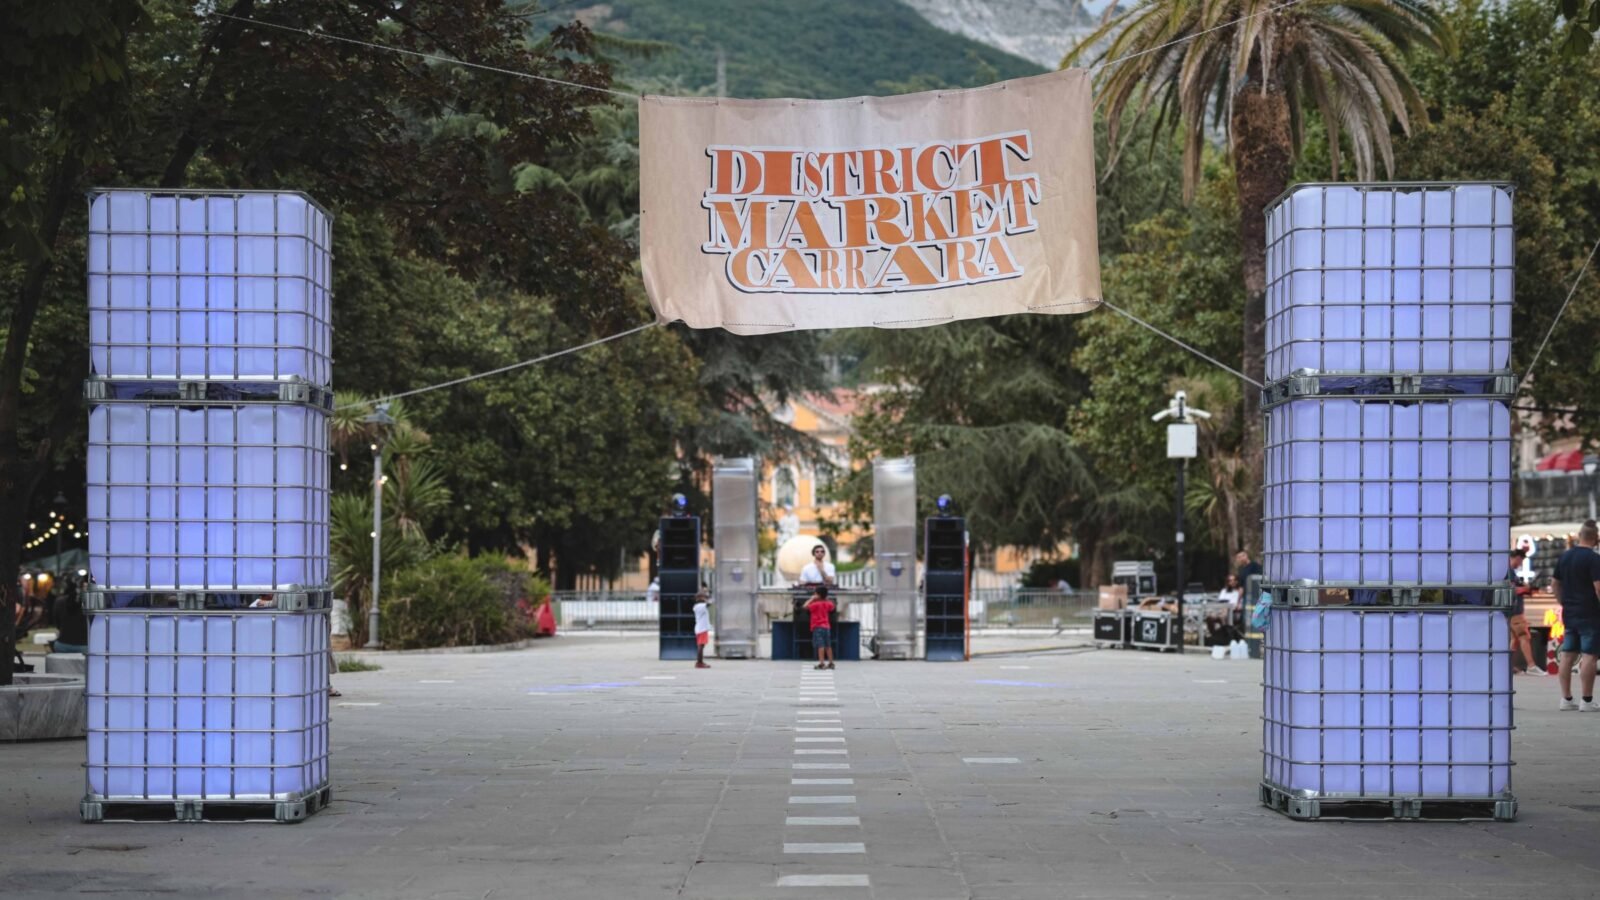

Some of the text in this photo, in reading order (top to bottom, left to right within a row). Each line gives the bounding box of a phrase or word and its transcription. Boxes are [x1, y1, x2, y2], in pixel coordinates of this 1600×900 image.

[709, 133, 1029, 197] DISTRICT
[705, 180, 1036, 249] MARKET
[731, 237, 1019, 290] CARRARA
